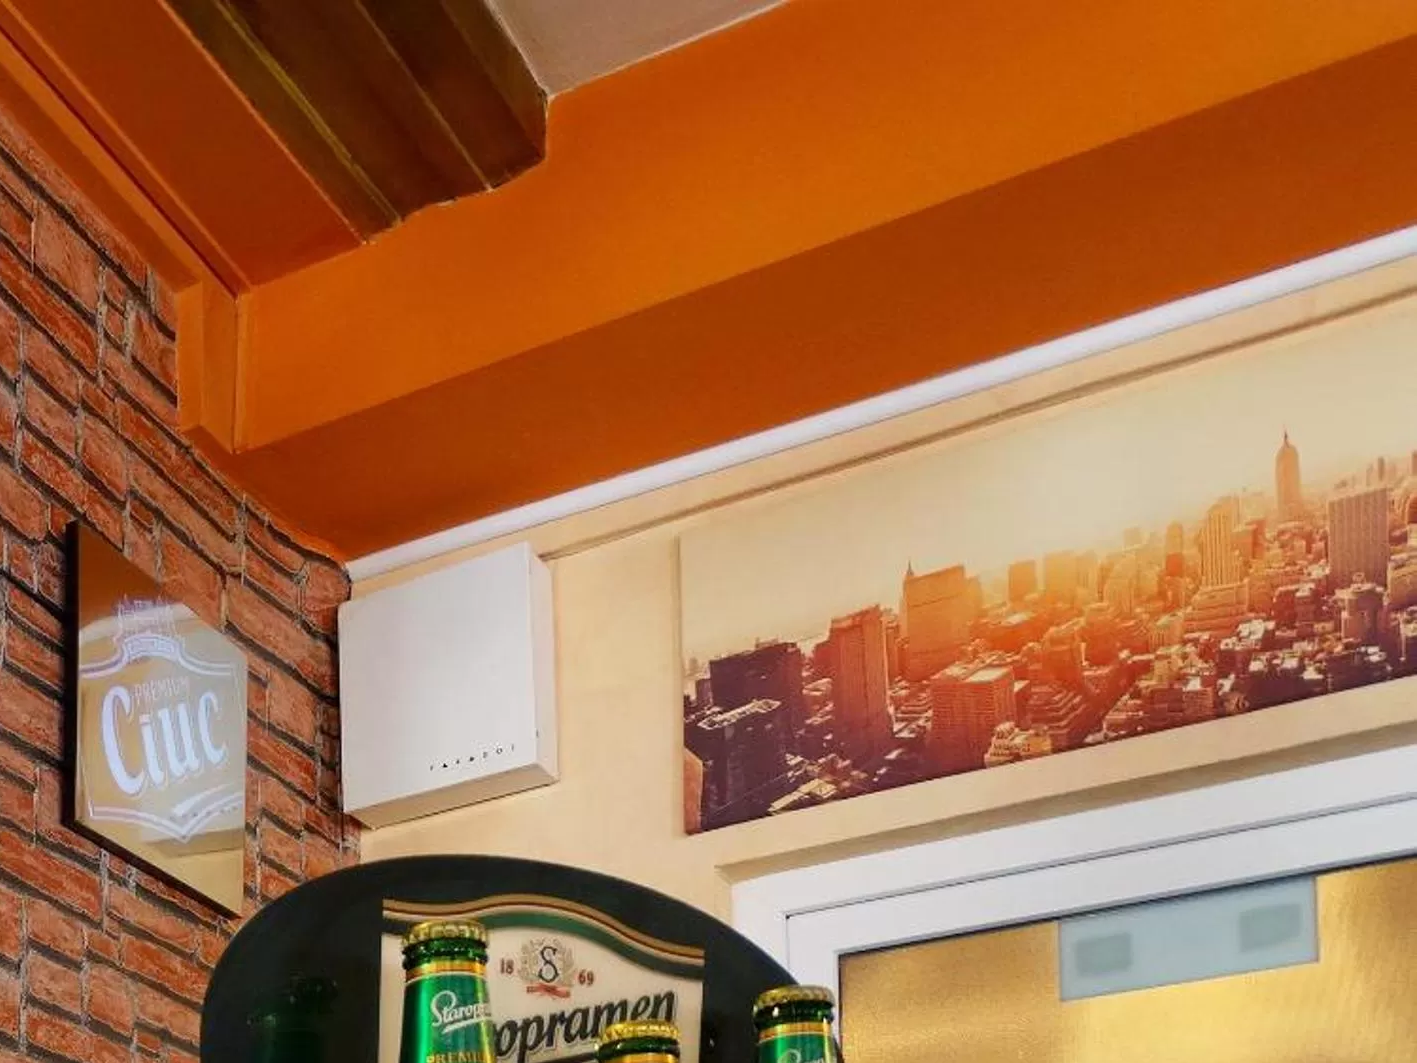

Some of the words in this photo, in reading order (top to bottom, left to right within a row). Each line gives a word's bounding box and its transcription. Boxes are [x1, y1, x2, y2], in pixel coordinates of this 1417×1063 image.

[102, 686, 227, 796] Ciuc
[499, 958, 515, 976] 18
[577, 968, 595, 987] 69
